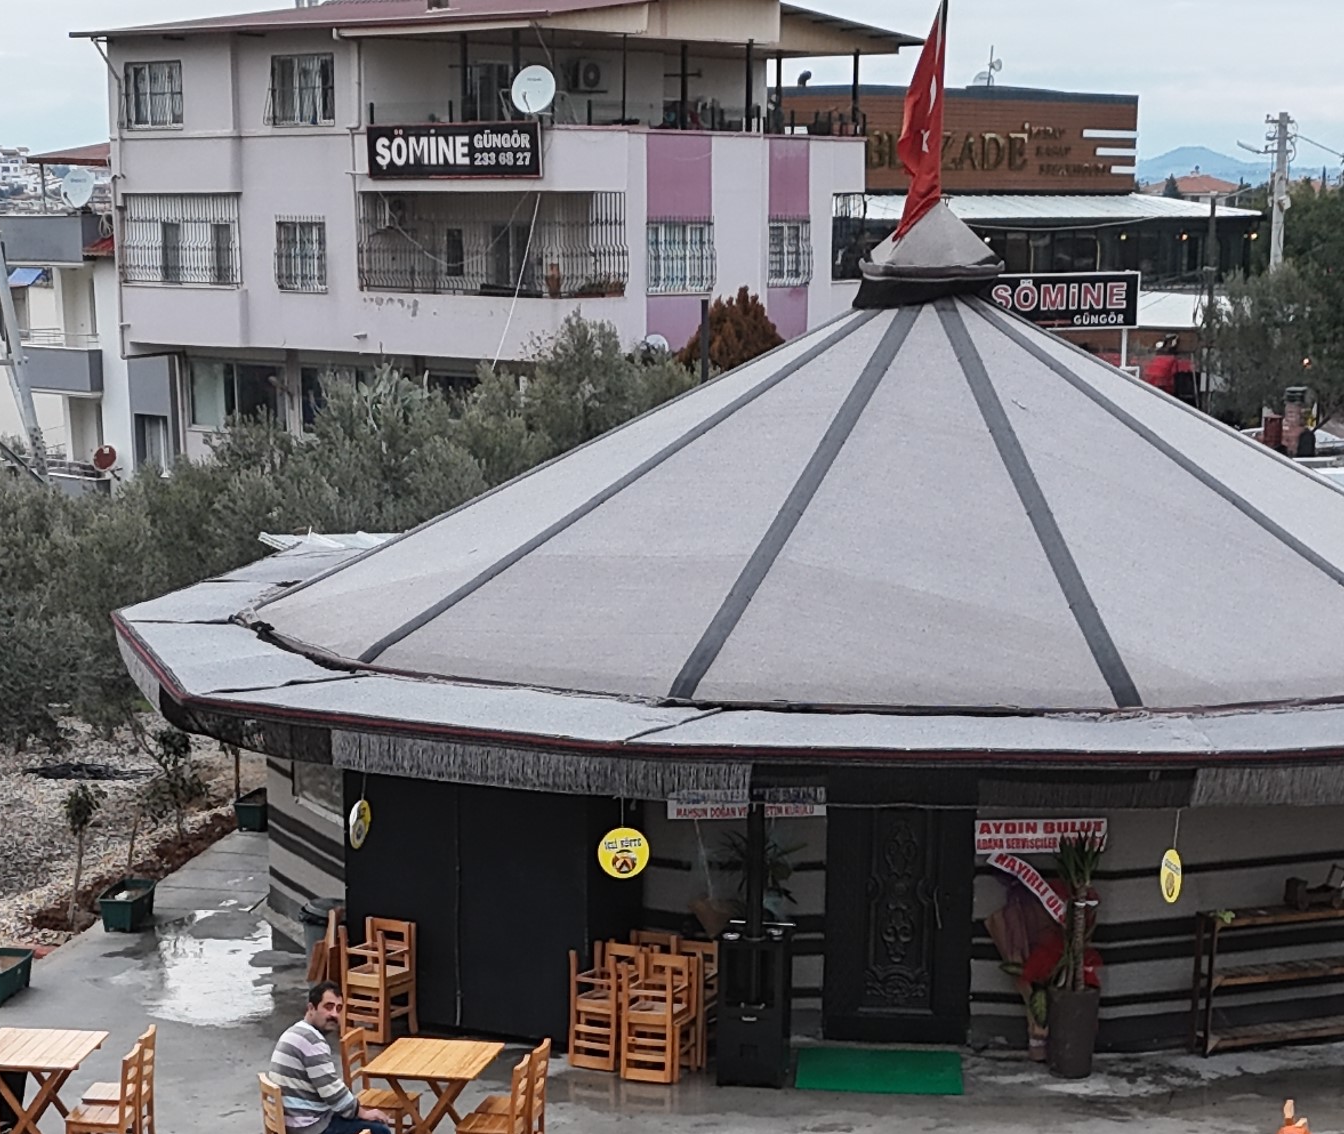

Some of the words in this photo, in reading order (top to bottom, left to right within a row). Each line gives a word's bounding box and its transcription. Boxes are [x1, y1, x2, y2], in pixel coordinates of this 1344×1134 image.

[473, 129, 531, 149] GÜNGÖR
[473, 152, 496, 166] 233
[516, 151, 532, 166] 27
[1073, 311, 1124, 325] GÜNGÖR
[979, 822, 1038, 835] AYDIN
[1043, 820, 1104, 834] BULUT
[994, 853, 1050, 897] HAYIRLI
